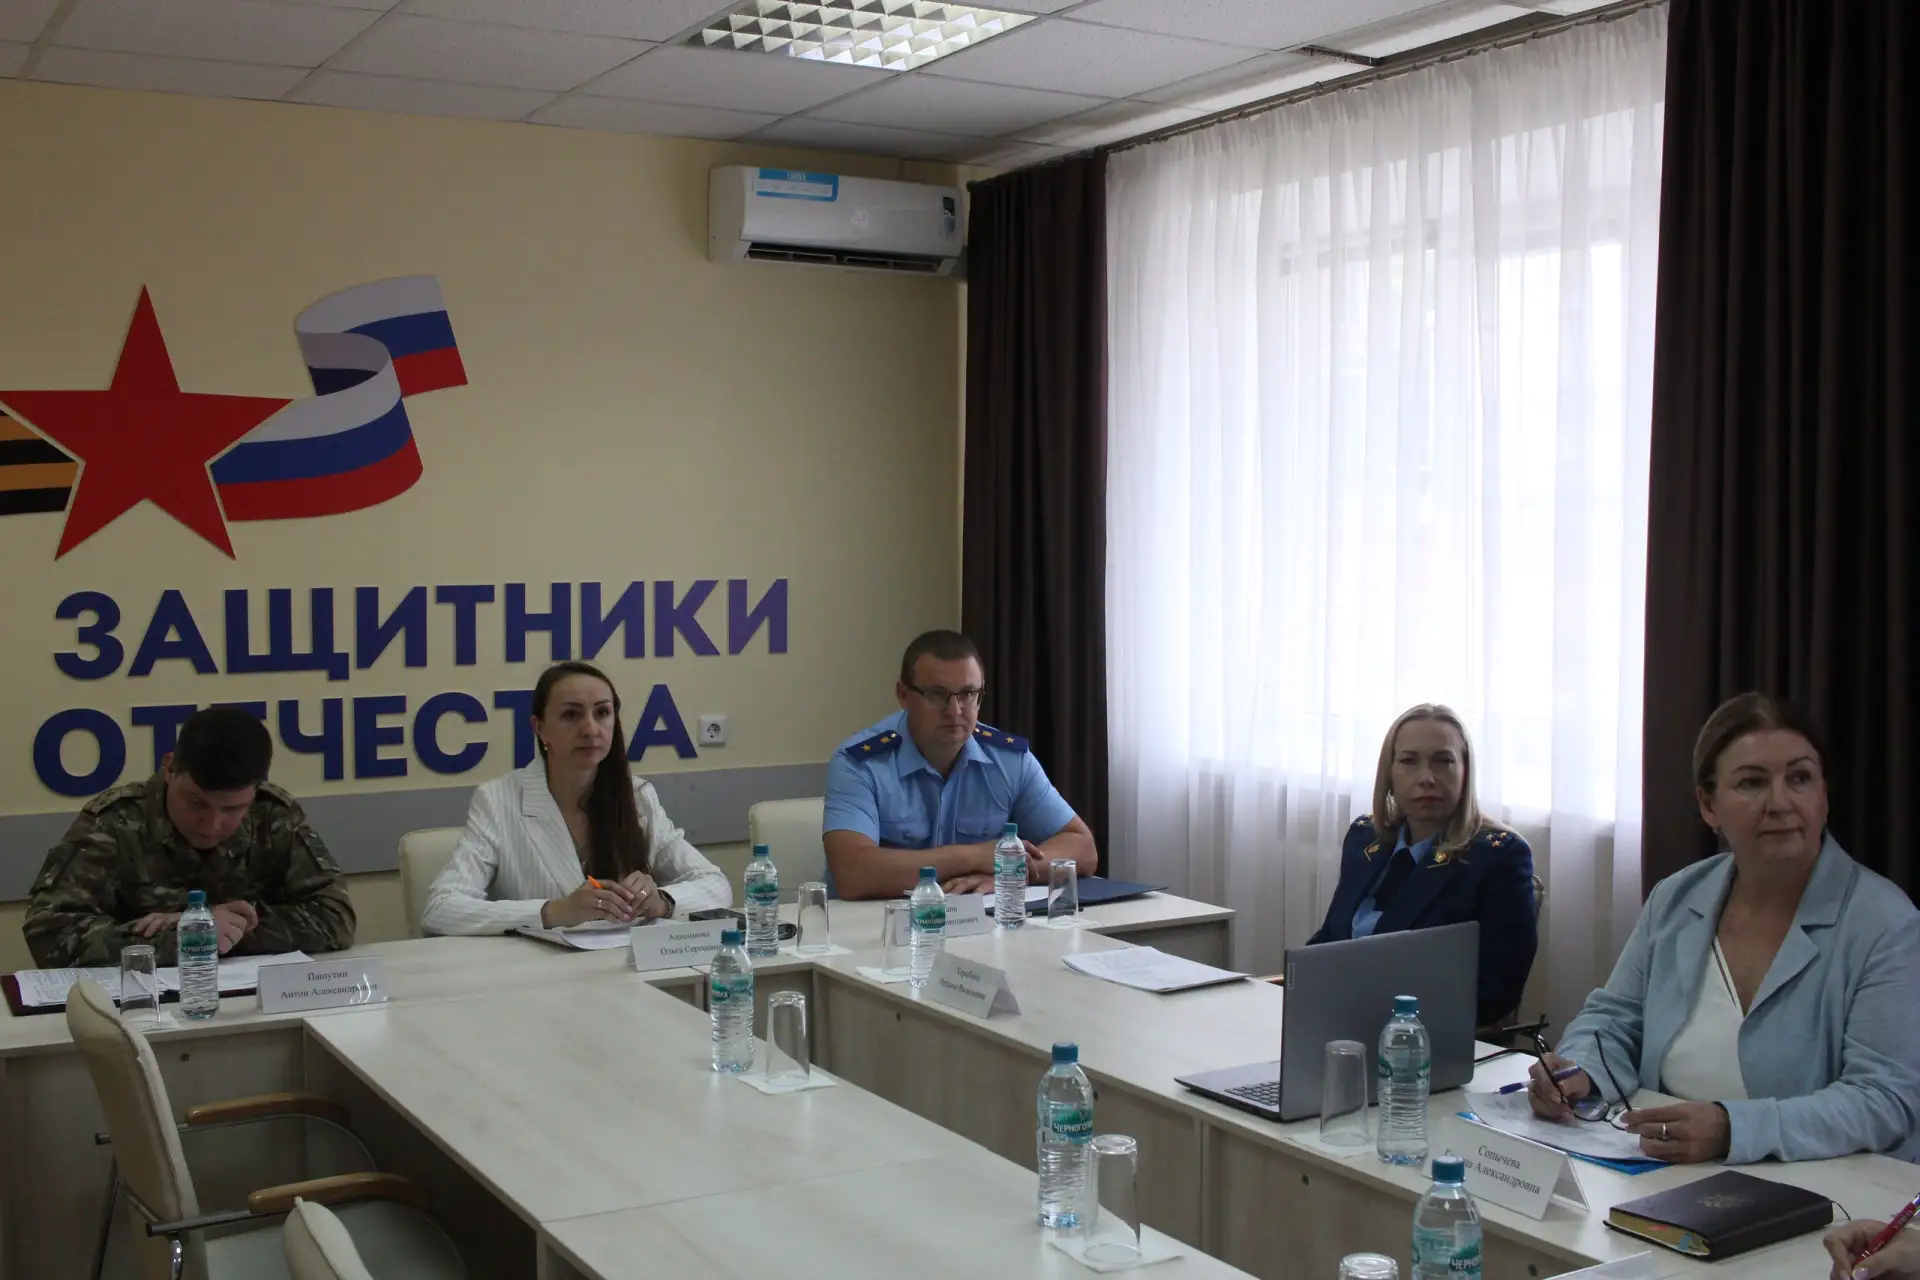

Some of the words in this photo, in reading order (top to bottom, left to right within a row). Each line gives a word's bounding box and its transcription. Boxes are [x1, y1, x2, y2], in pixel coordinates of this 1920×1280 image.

[53, 579, 788, 681] ЗАЩИТНИКИ
[33, 684, 698, 796] ОТЧЕСТА
[660, 946, 683, 956] Ольга
[280, 990, 309, 999] Антон
